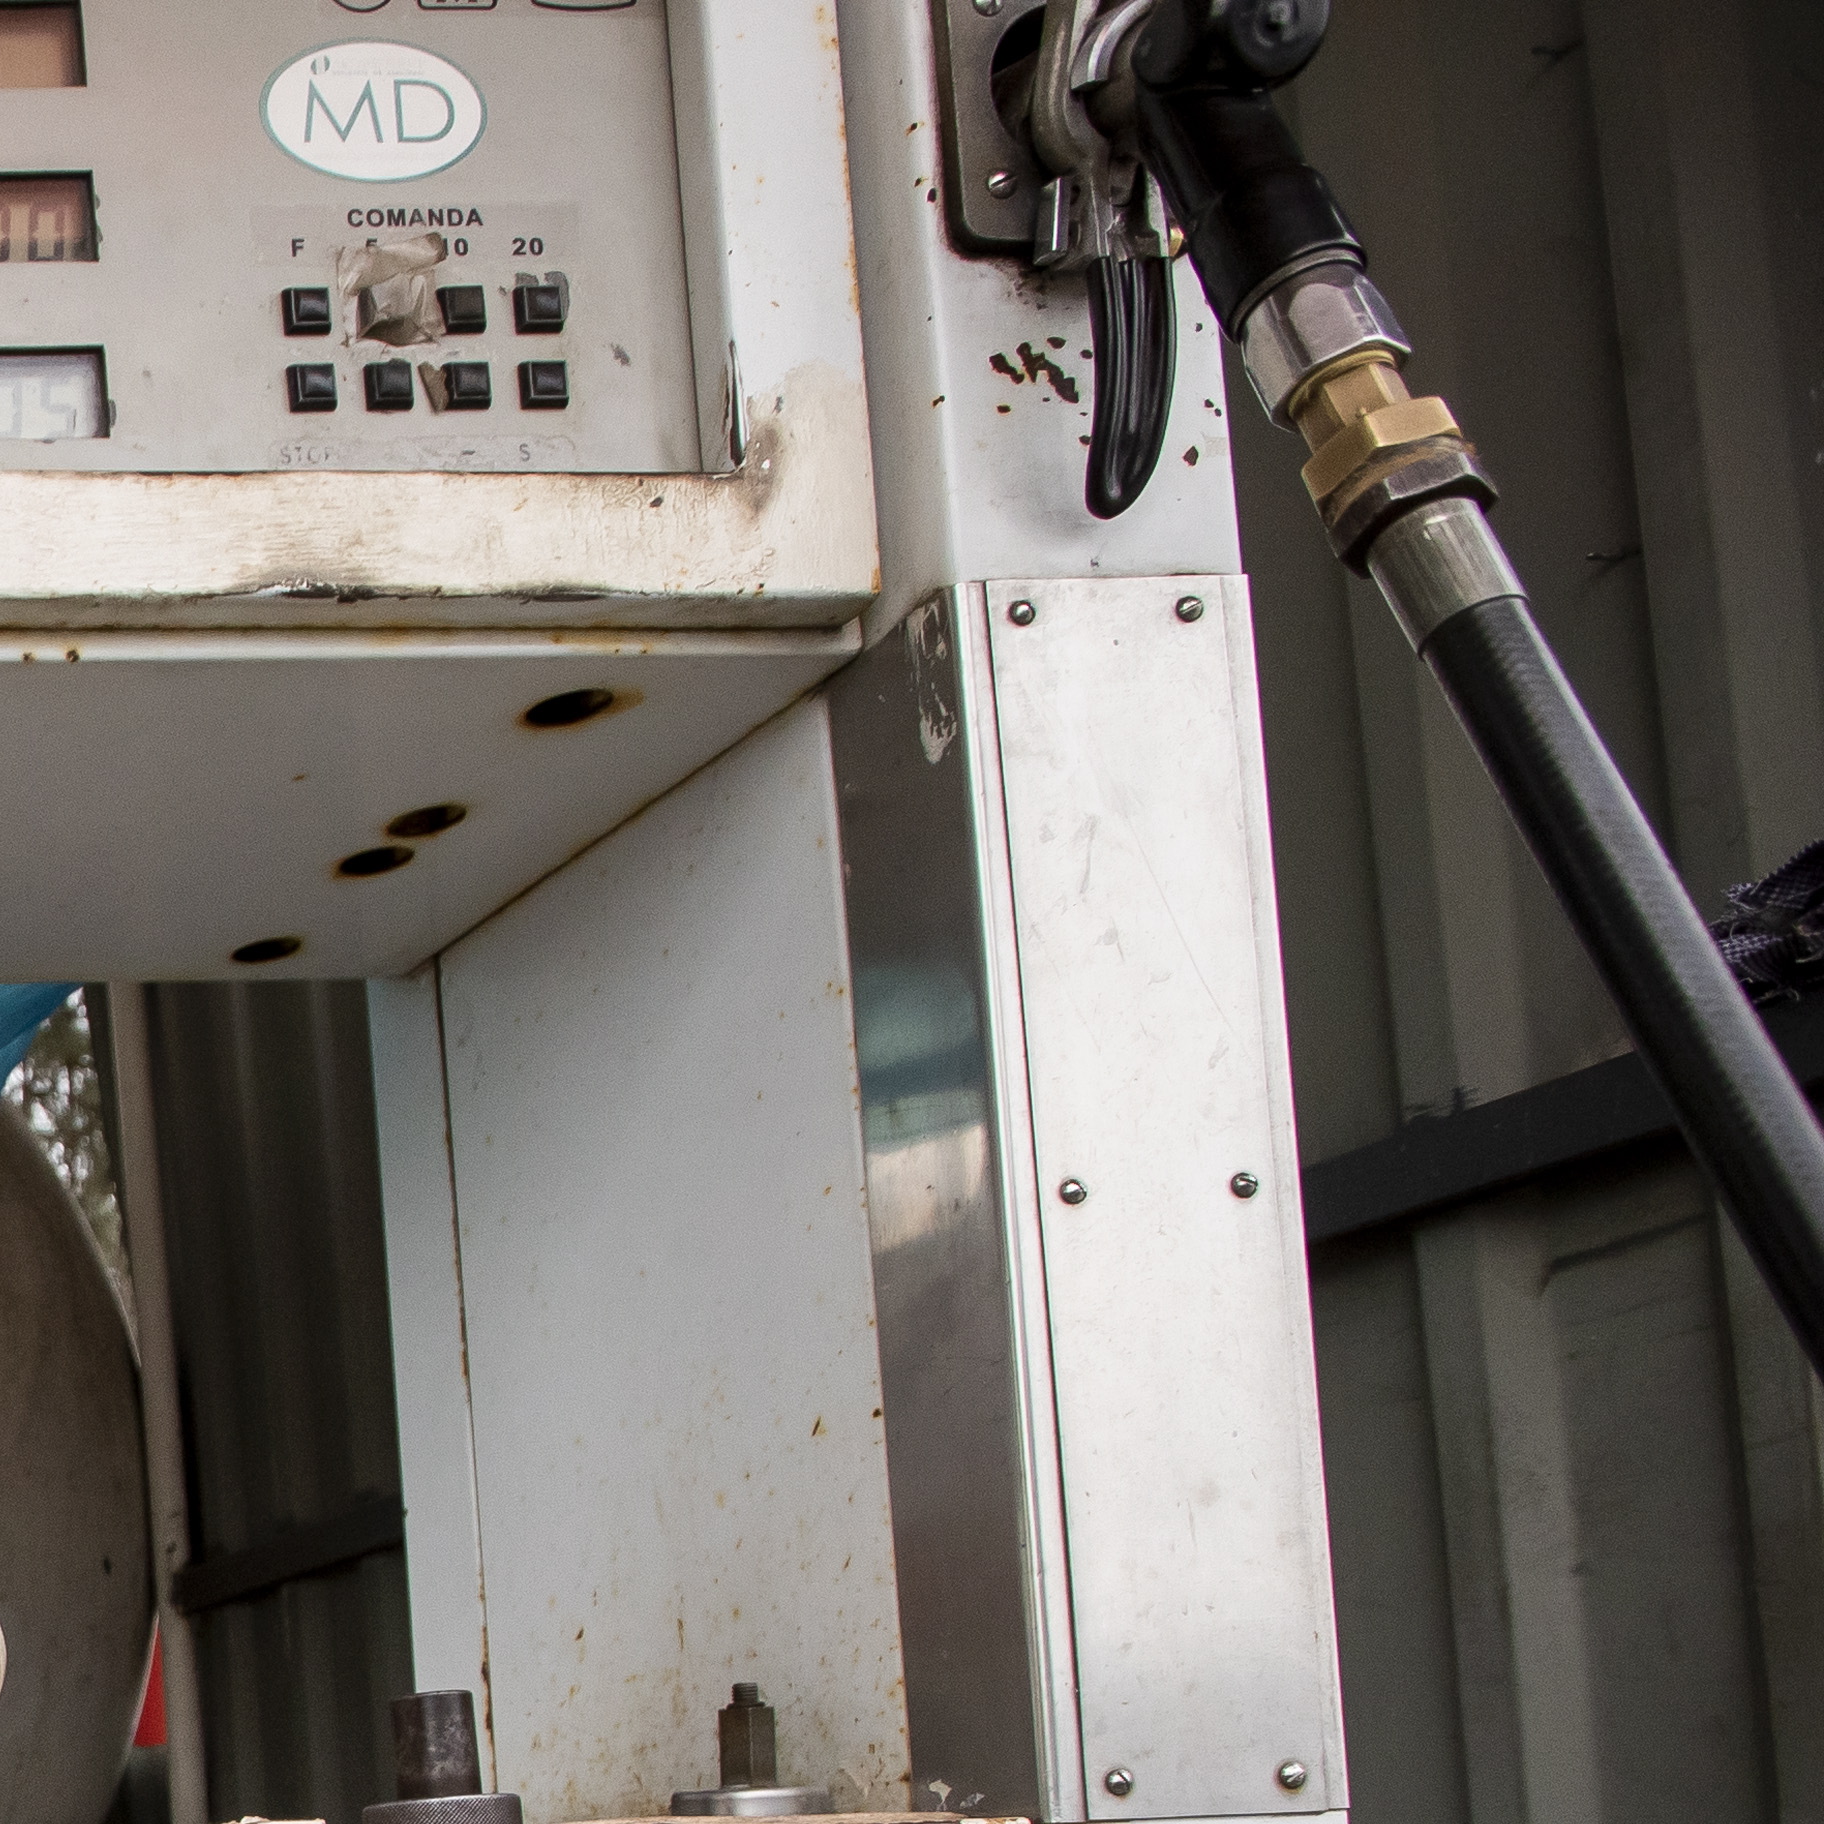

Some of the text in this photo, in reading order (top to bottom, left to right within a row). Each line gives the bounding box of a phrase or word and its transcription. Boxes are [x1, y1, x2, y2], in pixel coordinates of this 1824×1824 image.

[305, 80, 454, 142] MD
[348, 209, 482, 227] COMANDA
[291, 238, 305, 257] F
[512, 237, 543, 256] 20
[519, 444, 531, 461] S
